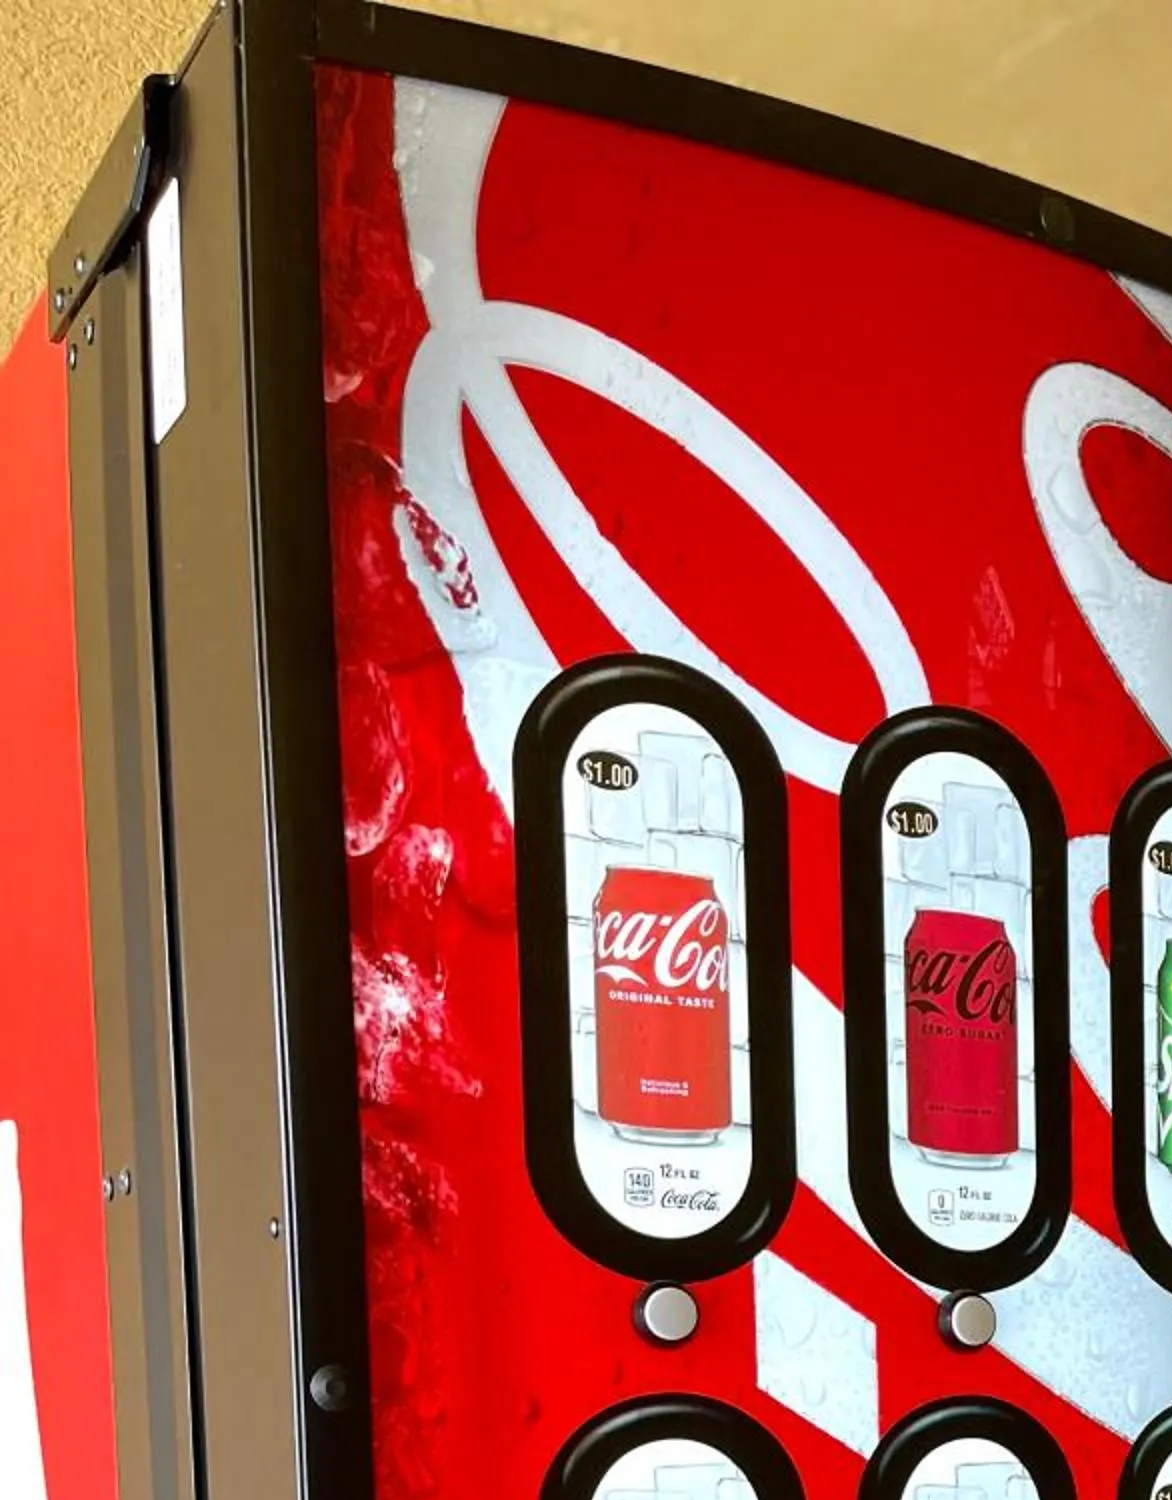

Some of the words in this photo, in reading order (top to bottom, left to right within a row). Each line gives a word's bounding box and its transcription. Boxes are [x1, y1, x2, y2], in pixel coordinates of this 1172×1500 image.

[583, 758, 633, 788] $1.00
[891, 810, 933, 834] $1.00
[608, 989, 672, 1006] ORIGINAL
[677, 995, 715, 1009] TASTE
[629, 1173, 651, 1188] 140
[659, 1163, 672, 1179] 12
